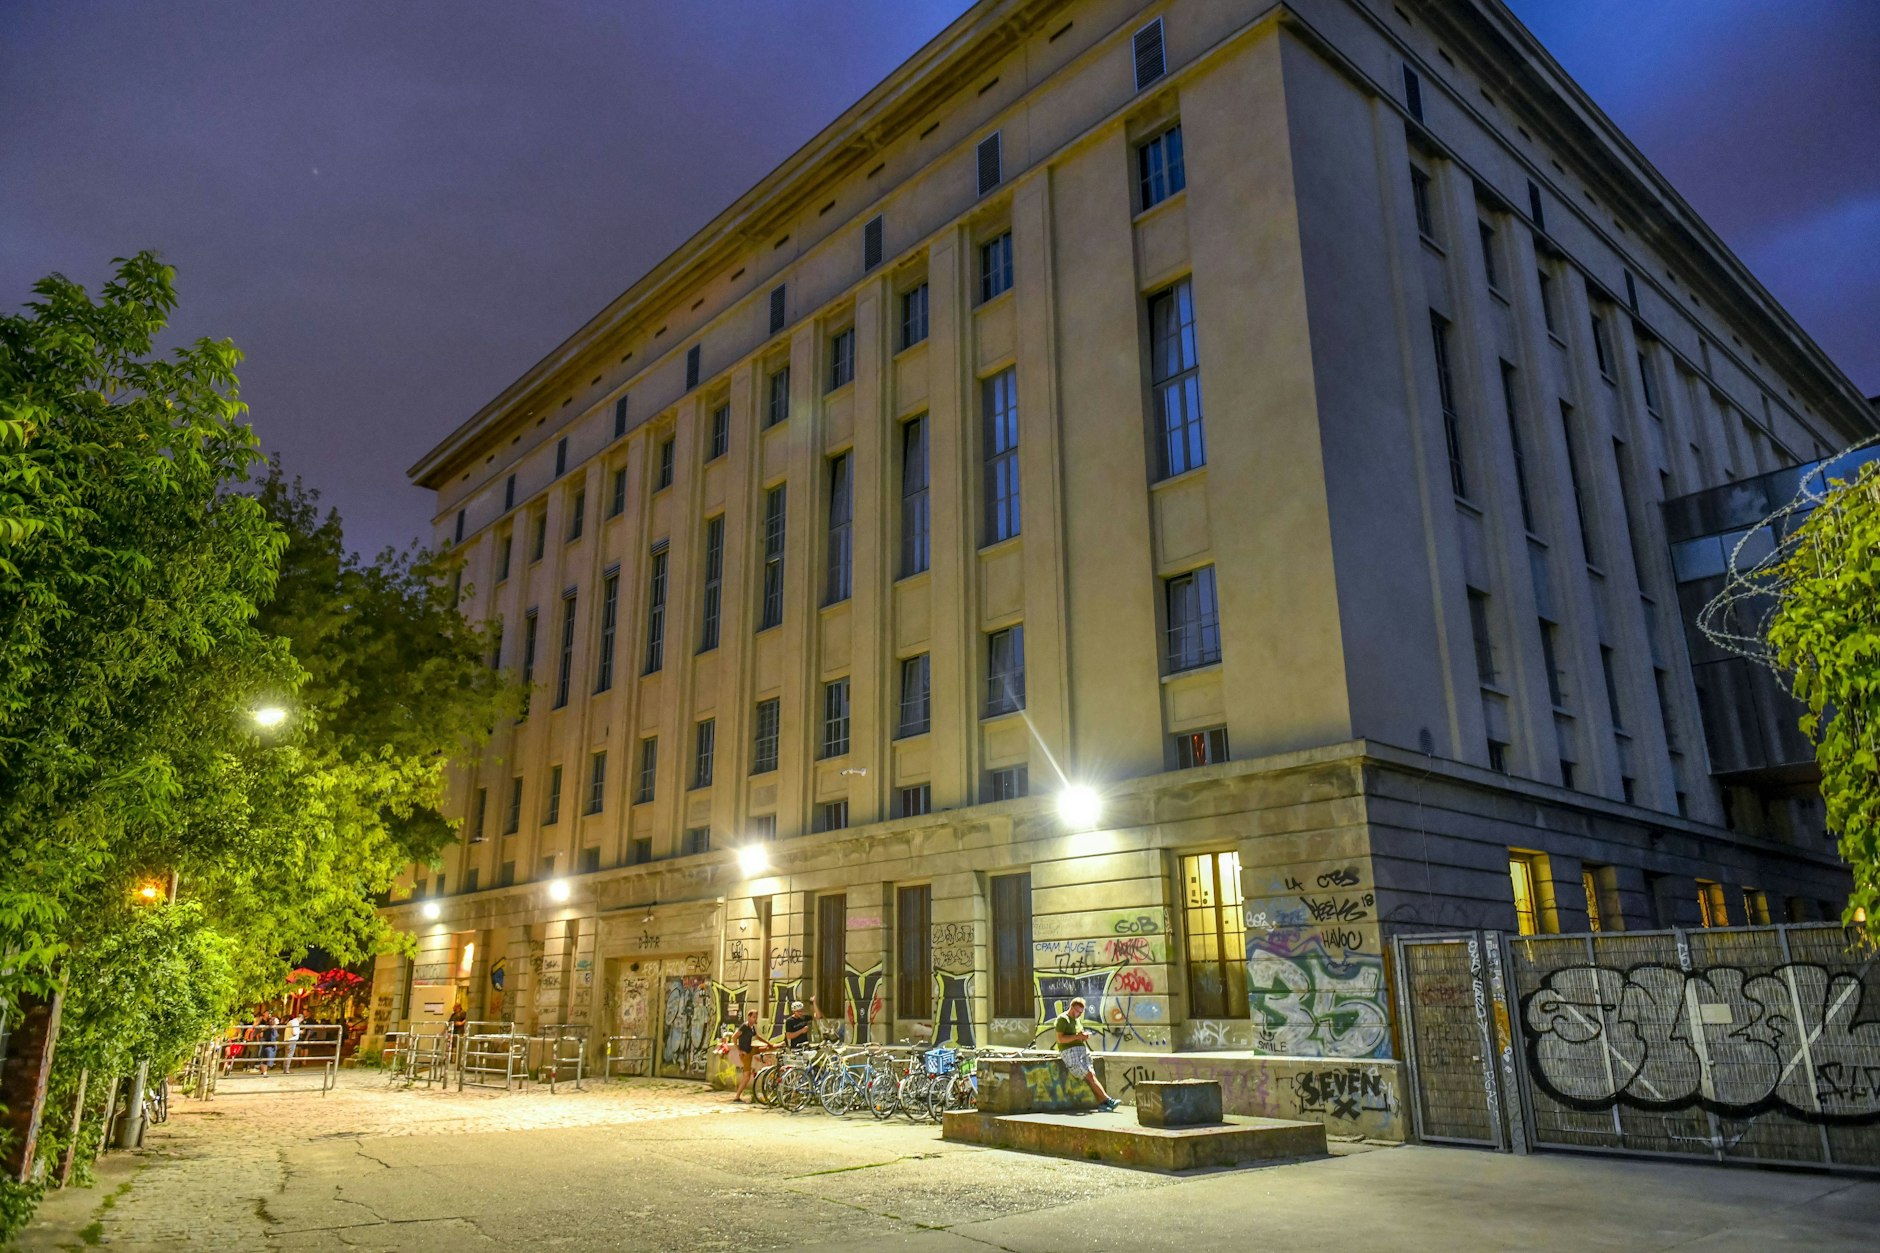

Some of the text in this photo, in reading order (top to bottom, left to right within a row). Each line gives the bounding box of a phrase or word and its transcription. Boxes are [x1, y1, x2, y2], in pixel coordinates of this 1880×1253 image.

[1321, 927, 1363, 950] HAVOC
[1257, 1040, 1288, 1052] SMILE
[1301, 1067, 1382, 1105] SEVEN
[1331, 1098, 1361, 1120] X
